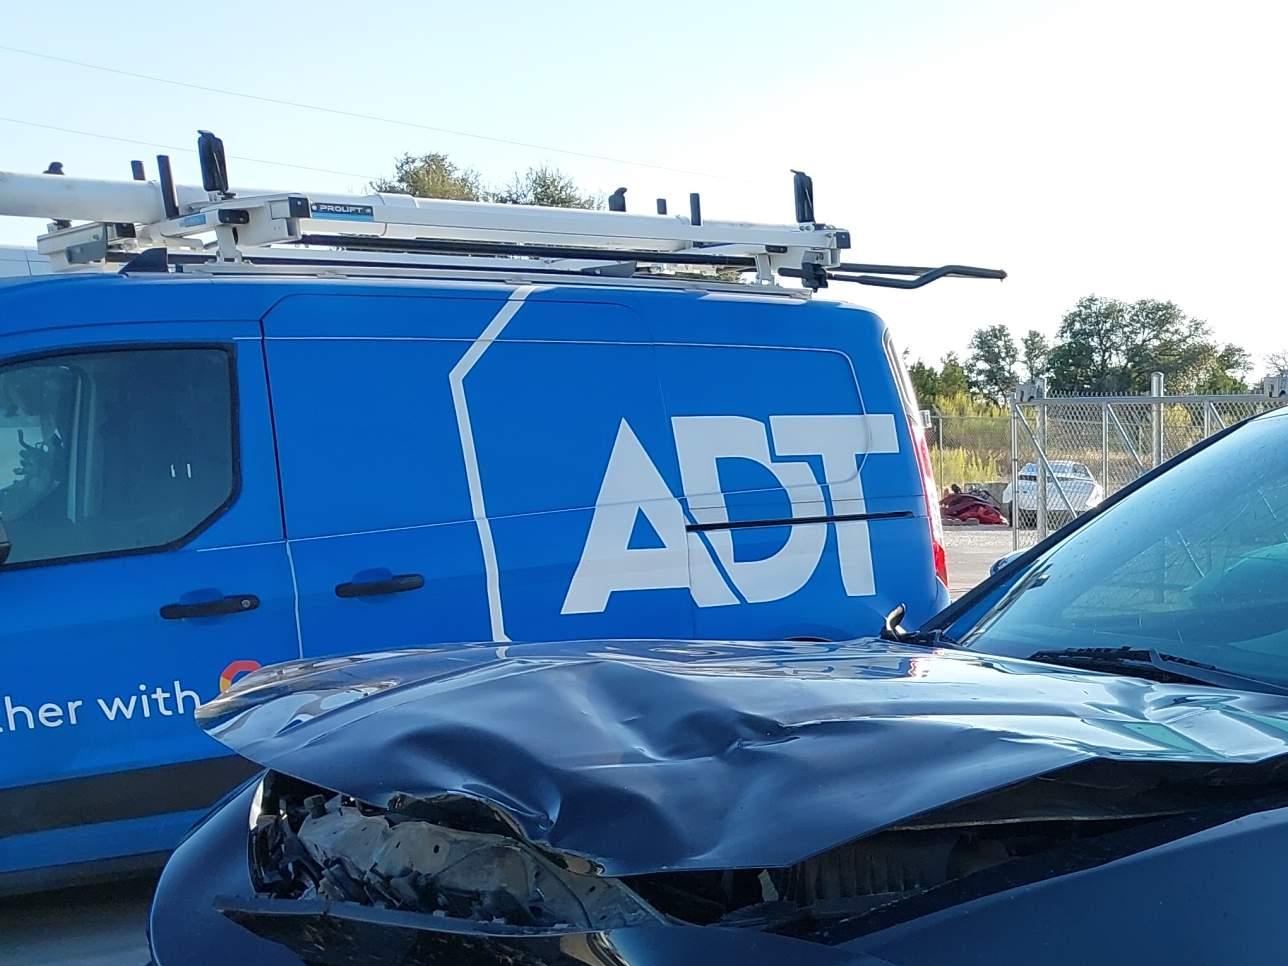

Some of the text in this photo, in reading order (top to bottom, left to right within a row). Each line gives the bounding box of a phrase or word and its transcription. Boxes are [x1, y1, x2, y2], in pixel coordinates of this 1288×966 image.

[320, 205, 362, 213] PROLIFT
[560, 414, 900, 614] ADT
[0, 681, 202, 732] her with
